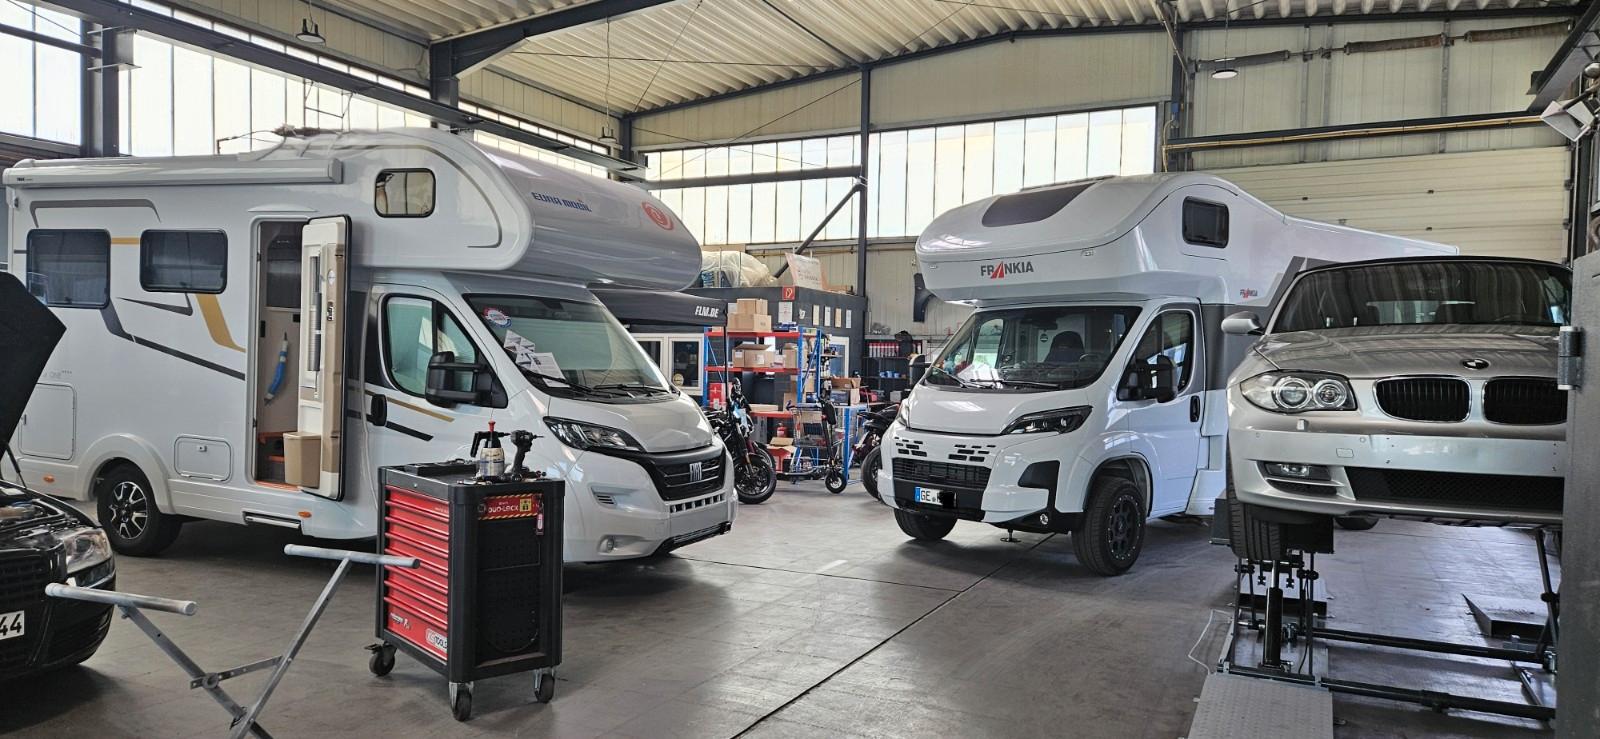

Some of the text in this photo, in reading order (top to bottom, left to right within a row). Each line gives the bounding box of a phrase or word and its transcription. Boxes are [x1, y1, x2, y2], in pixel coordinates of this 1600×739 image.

[531, 191, 562, 206] EURA
[980, 260, 1034, 279] FRANKIA
[689, 461, 702, 482] FIAT
[920, 490, 931, 502] GE
